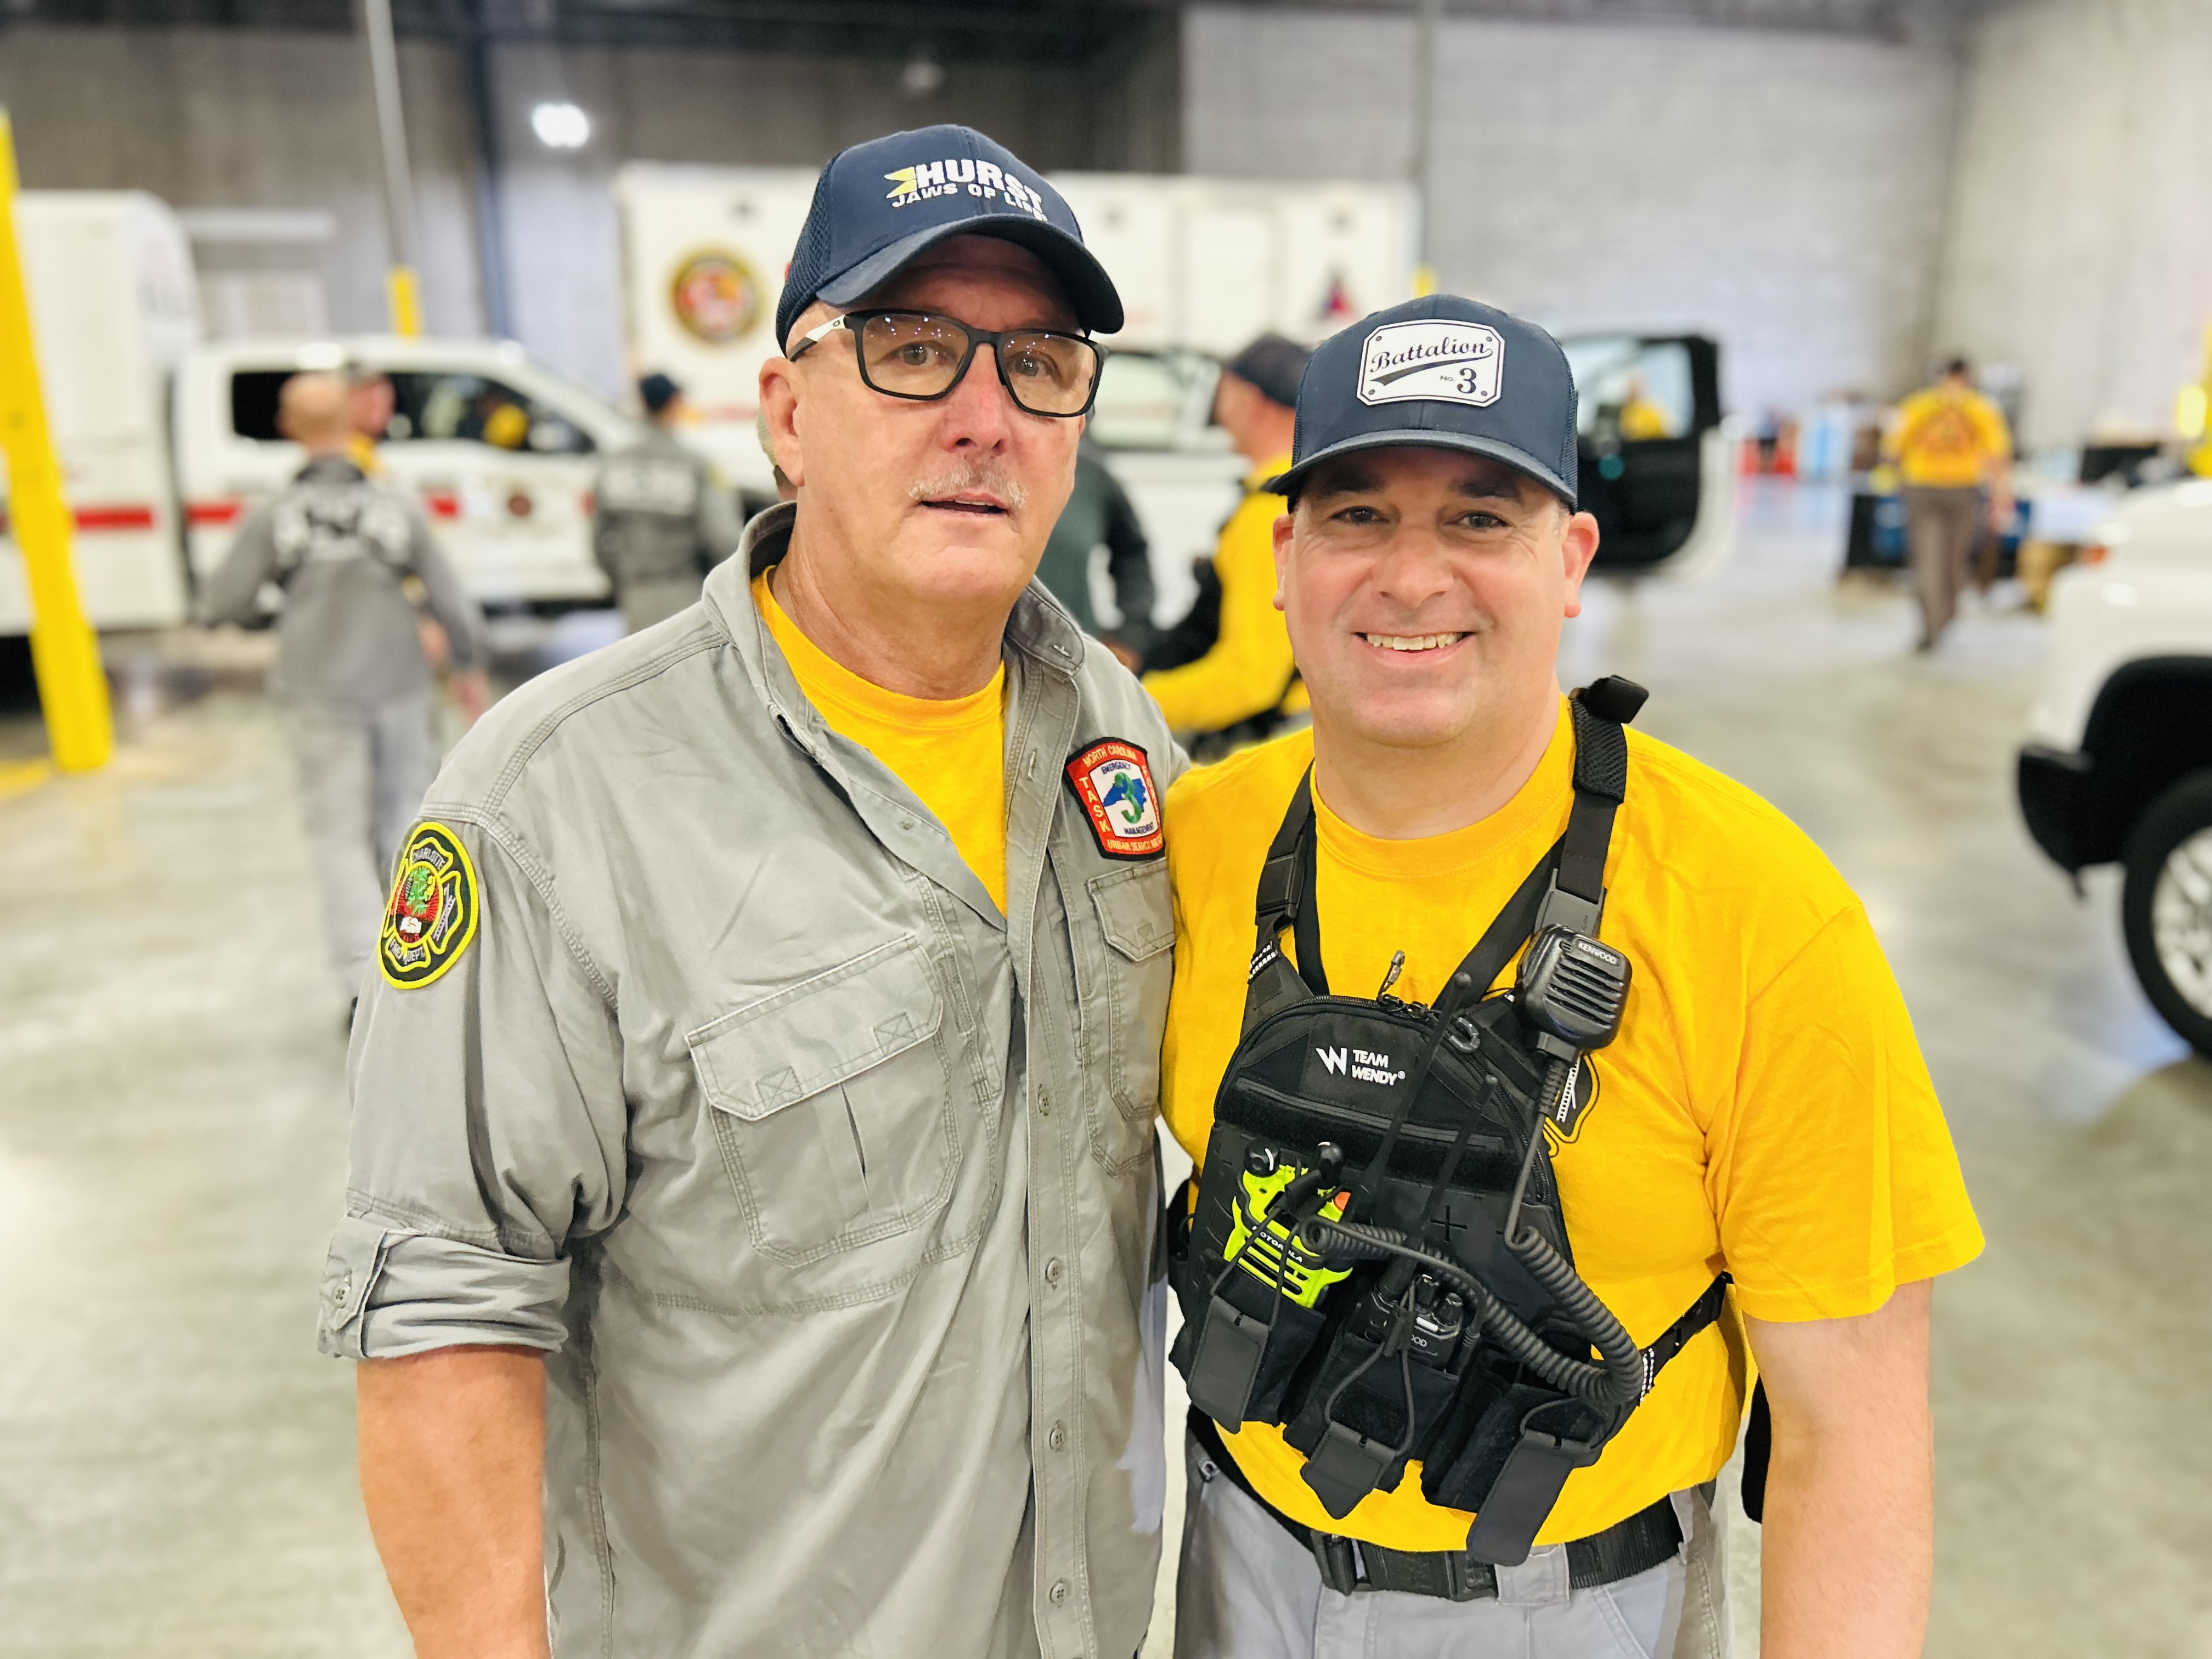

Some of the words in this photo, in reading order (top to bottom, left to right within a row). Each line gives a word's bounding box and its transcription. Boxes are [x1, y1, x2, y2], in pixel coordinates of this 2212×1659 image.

[892, 183, 957, 208] JAWS
[968, 184, 996, 199] OF
[916, 159, 1043, 213] HURST
[1370, 337, 1486, 373] Battalion
[1457, 368, 1477, 394] 3
[1082, 747, 1108, 768] NORTH
[1108, 745, 1137, 761] CAROLINA
[1079, 776, 1111, 833] TASK
[1107, 839, 1131, 851] URBAN
[1578, 941, 1617, 964] KENWOOD
[1352, 1049, 1389, 1068] TEAM
